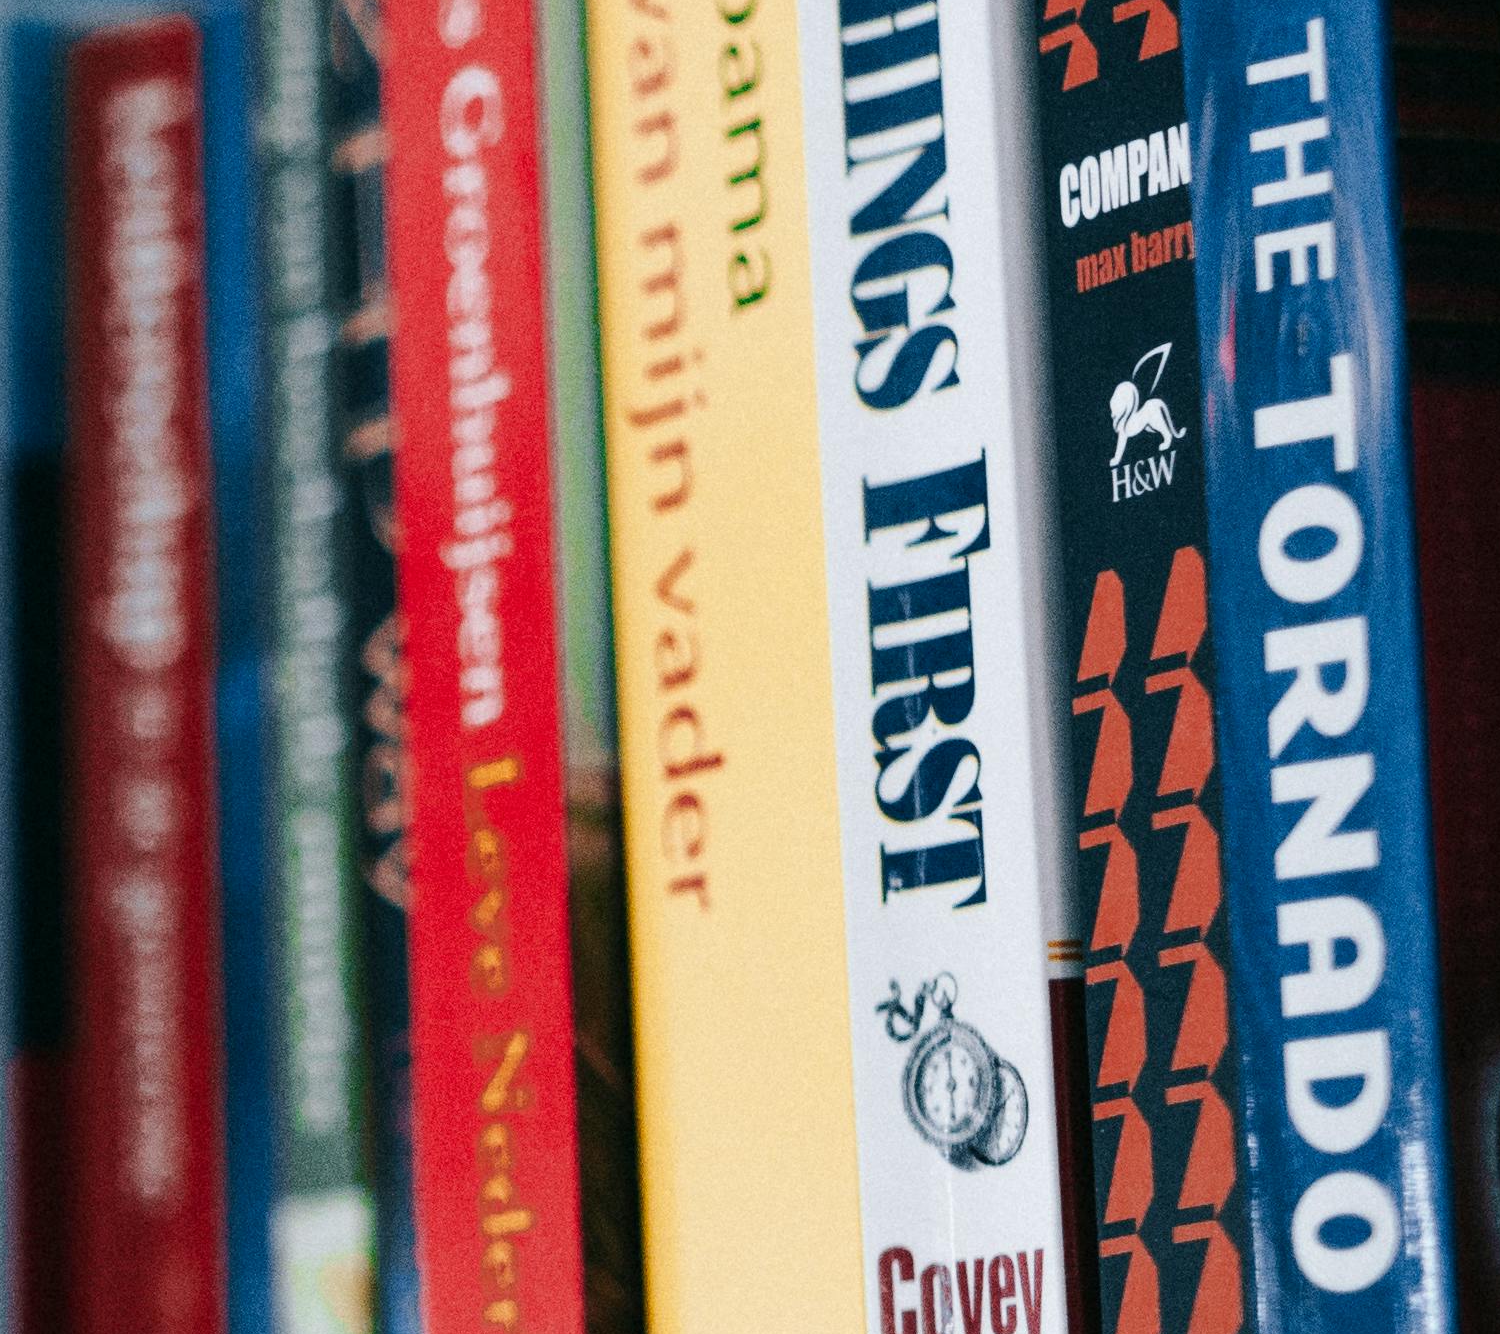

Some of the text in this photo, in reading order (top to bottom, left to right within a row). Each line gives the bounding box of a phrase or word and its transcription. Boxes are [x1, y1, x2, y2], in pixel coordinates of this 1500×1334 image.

[1059, 122, 1193, 229] COMPAN
[1076, 240, 1127, 294] max
[1245, 17, 1337, 294] THE
[629, 220, 710, 516] mijn
[1111, 450, 1177, 503] H&W
[652, 544, 727, 915] vader
[863, 447, 992, 911] FIRST
[1253, 354, 1400, 1294] TORNADO
